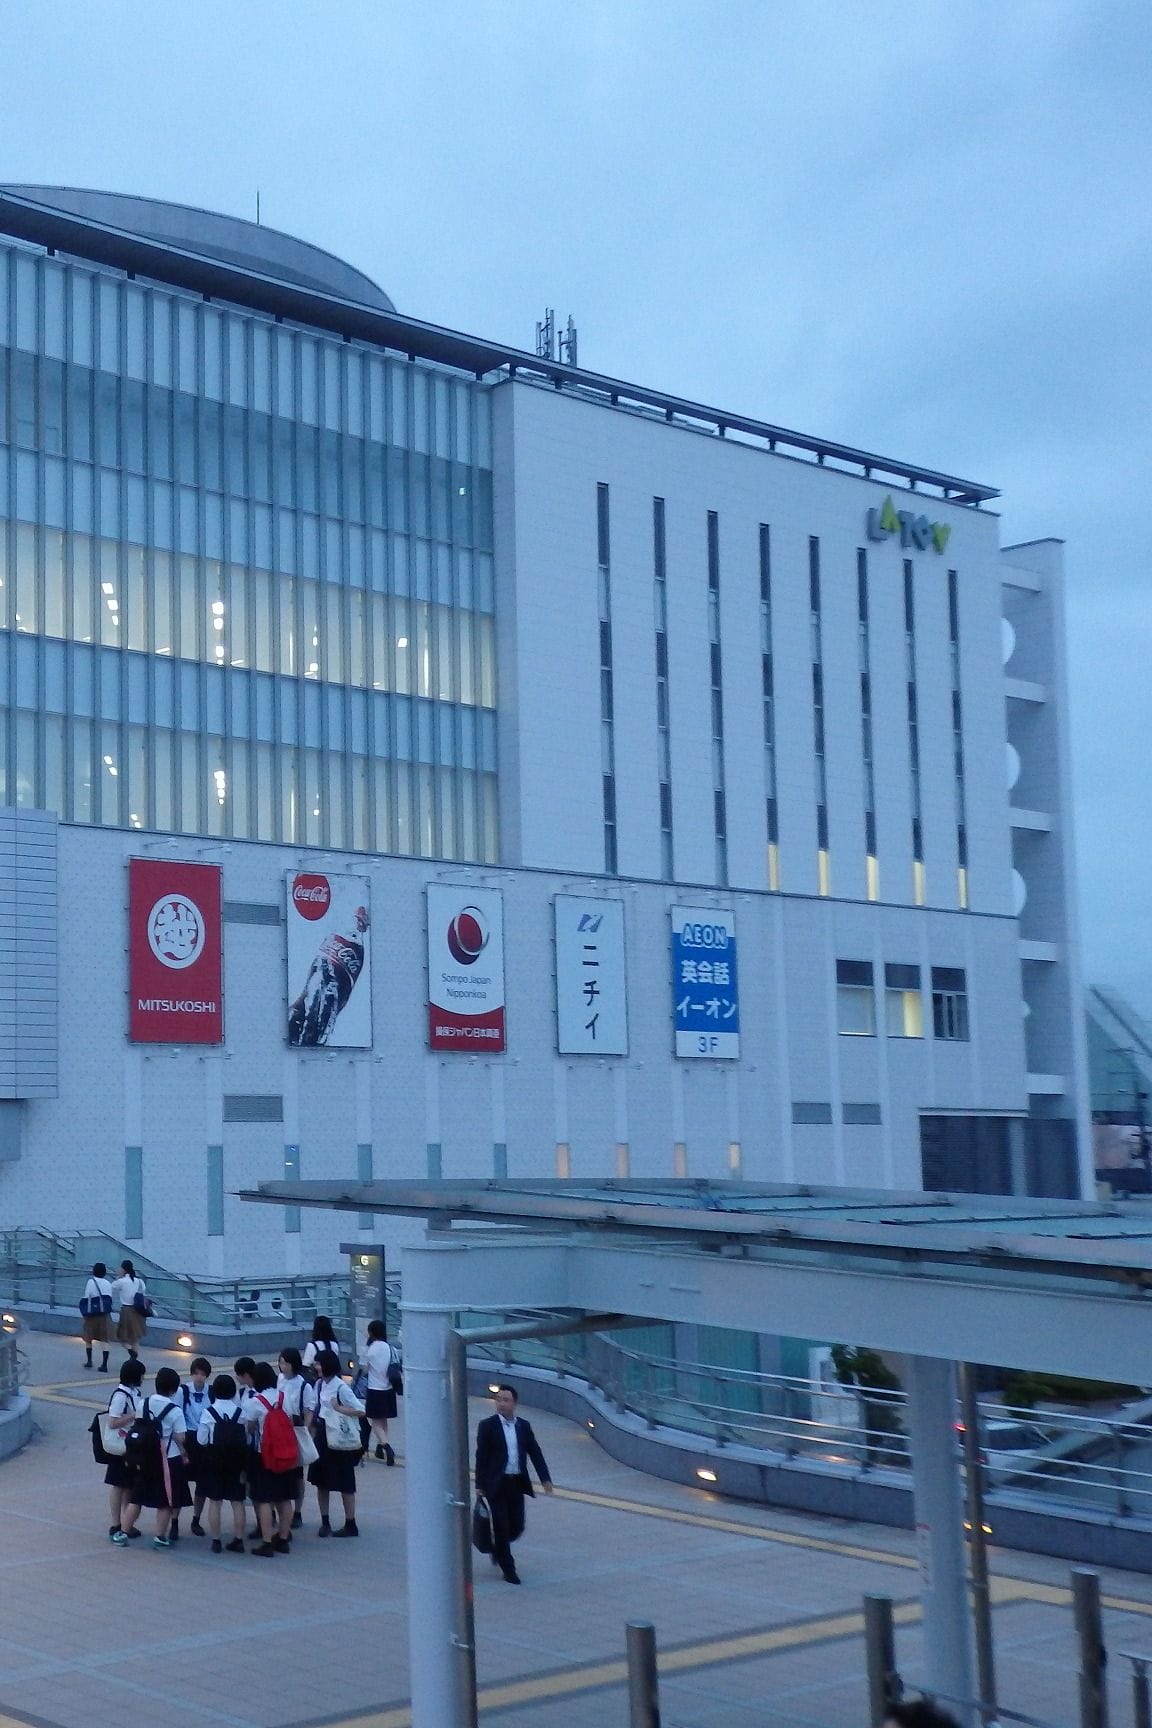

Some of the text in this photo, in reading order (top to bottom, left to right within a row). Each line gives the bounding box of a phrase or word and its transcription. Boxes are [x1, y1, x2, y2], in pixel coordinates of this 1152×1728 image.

[866, 494, 951, 555] LATOV
[682, 922, 728, 949] AEON
[441, 973, 491, 985] Sompo Japan
[681, 959, 730, 985] 英会話
[446, 988, 487, 1000] Nipponkoa
[582, 945, 600, 1040] ニチイ
[138, 999, 216, 1013] MITSUKOSHI
[676, 995, 736, 1019] イーオン
[698, 1036, 719, 1053] 3F
[360, 1255, 369, 1266] G
